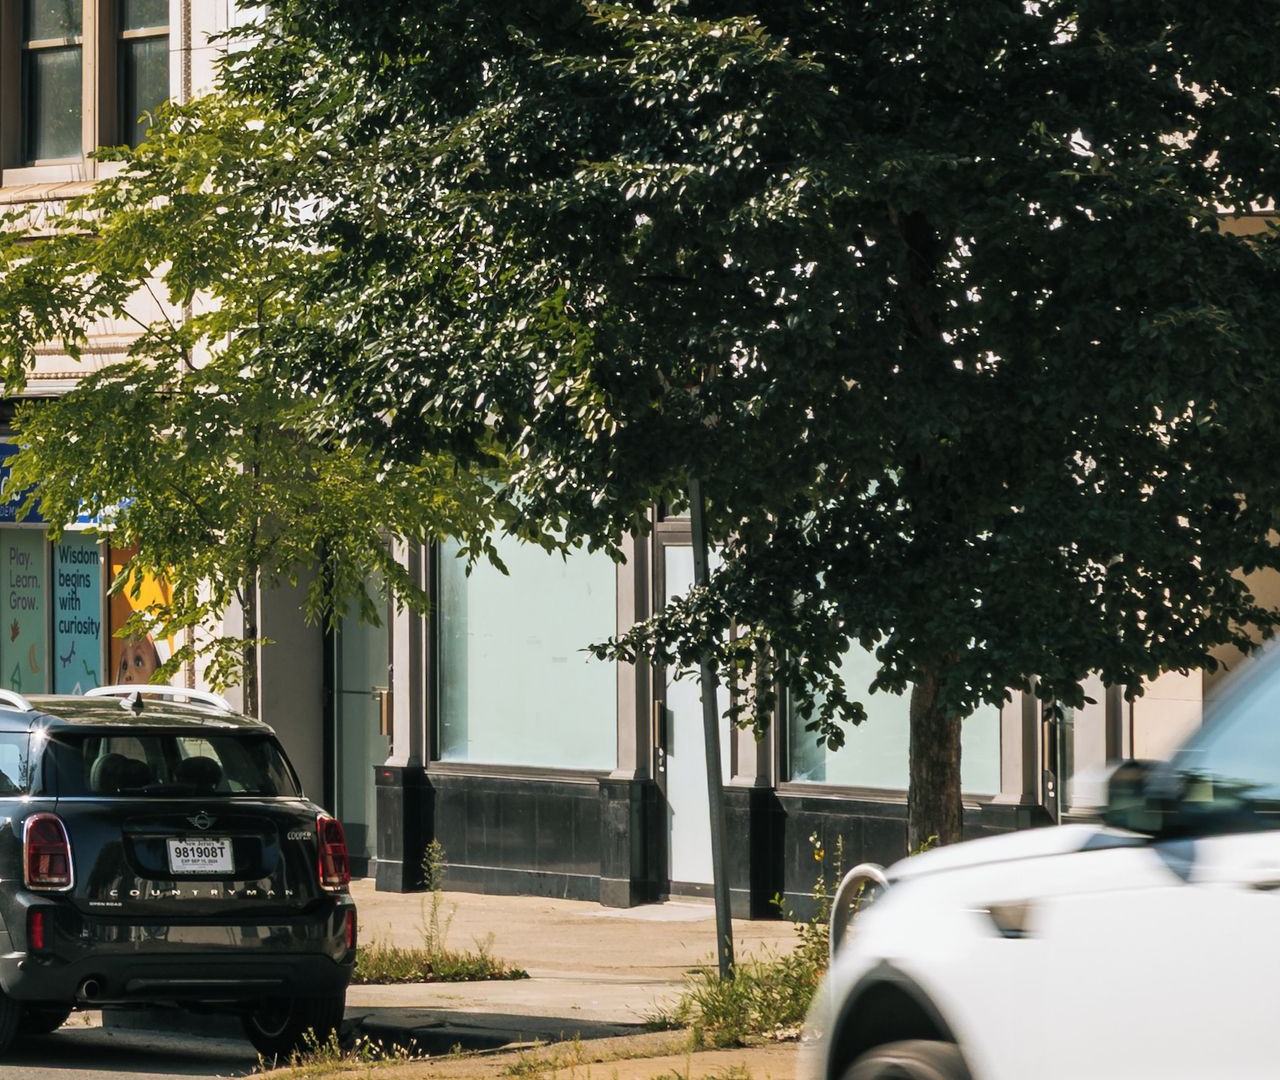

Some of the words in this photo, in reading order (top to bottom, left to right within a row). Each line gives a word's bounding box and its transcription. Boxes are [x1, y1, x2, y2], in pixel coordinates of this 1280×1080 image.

[9, 547, 33, 570] Play.
[59, 545, 98, 564] Wisdom
[9, 572, 40, 589] Learn.
[58, 570, 91, 598] begins
[9, 591, 38, 611] Grow.
[58, 593, 81, 611] with
[58, 616, 101, 640] curiosity
[287, 831, 312, 841] COOPER
[174, 846, 226, 859] 981908T
[109, 889, 294, 897] COUNTRYMAN
